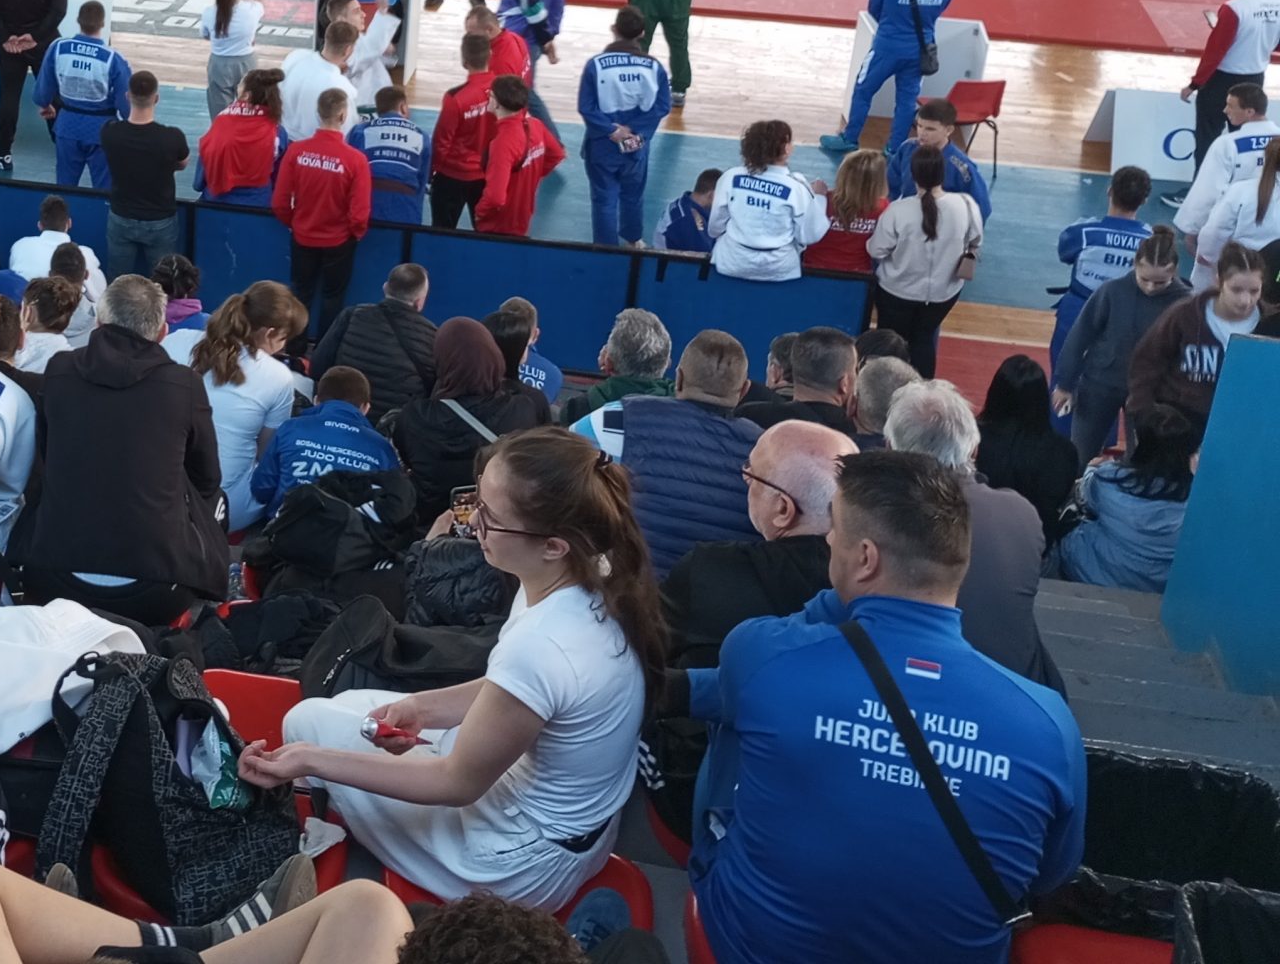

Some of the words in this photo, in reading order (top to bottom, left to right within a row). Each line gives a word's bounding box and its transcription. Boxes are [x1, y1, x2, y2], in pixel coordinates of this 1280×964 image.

[72, 59, 92, 71] BIH
[619, 73, 641, 82] BIH
[380, 132, 408, 143] BIH
[297, 155, 321, 168] NOVA
[322, 161, 345, 173] BILA
[746, 196, 771, 210] BIH
[1104, 253, 1135, 267] BIH
[295, 439, 322, 449] BOSNA
[300, 449, 335, 462] JUDO
[337, 456, 371, 471] KLUB
[858, 699, 918, 724] JU
[923, 712, 979, 741] KLUB
[815, 715, 1011, 781] HERCEOVINA
[860, 758, 963, 797] TREBIE
